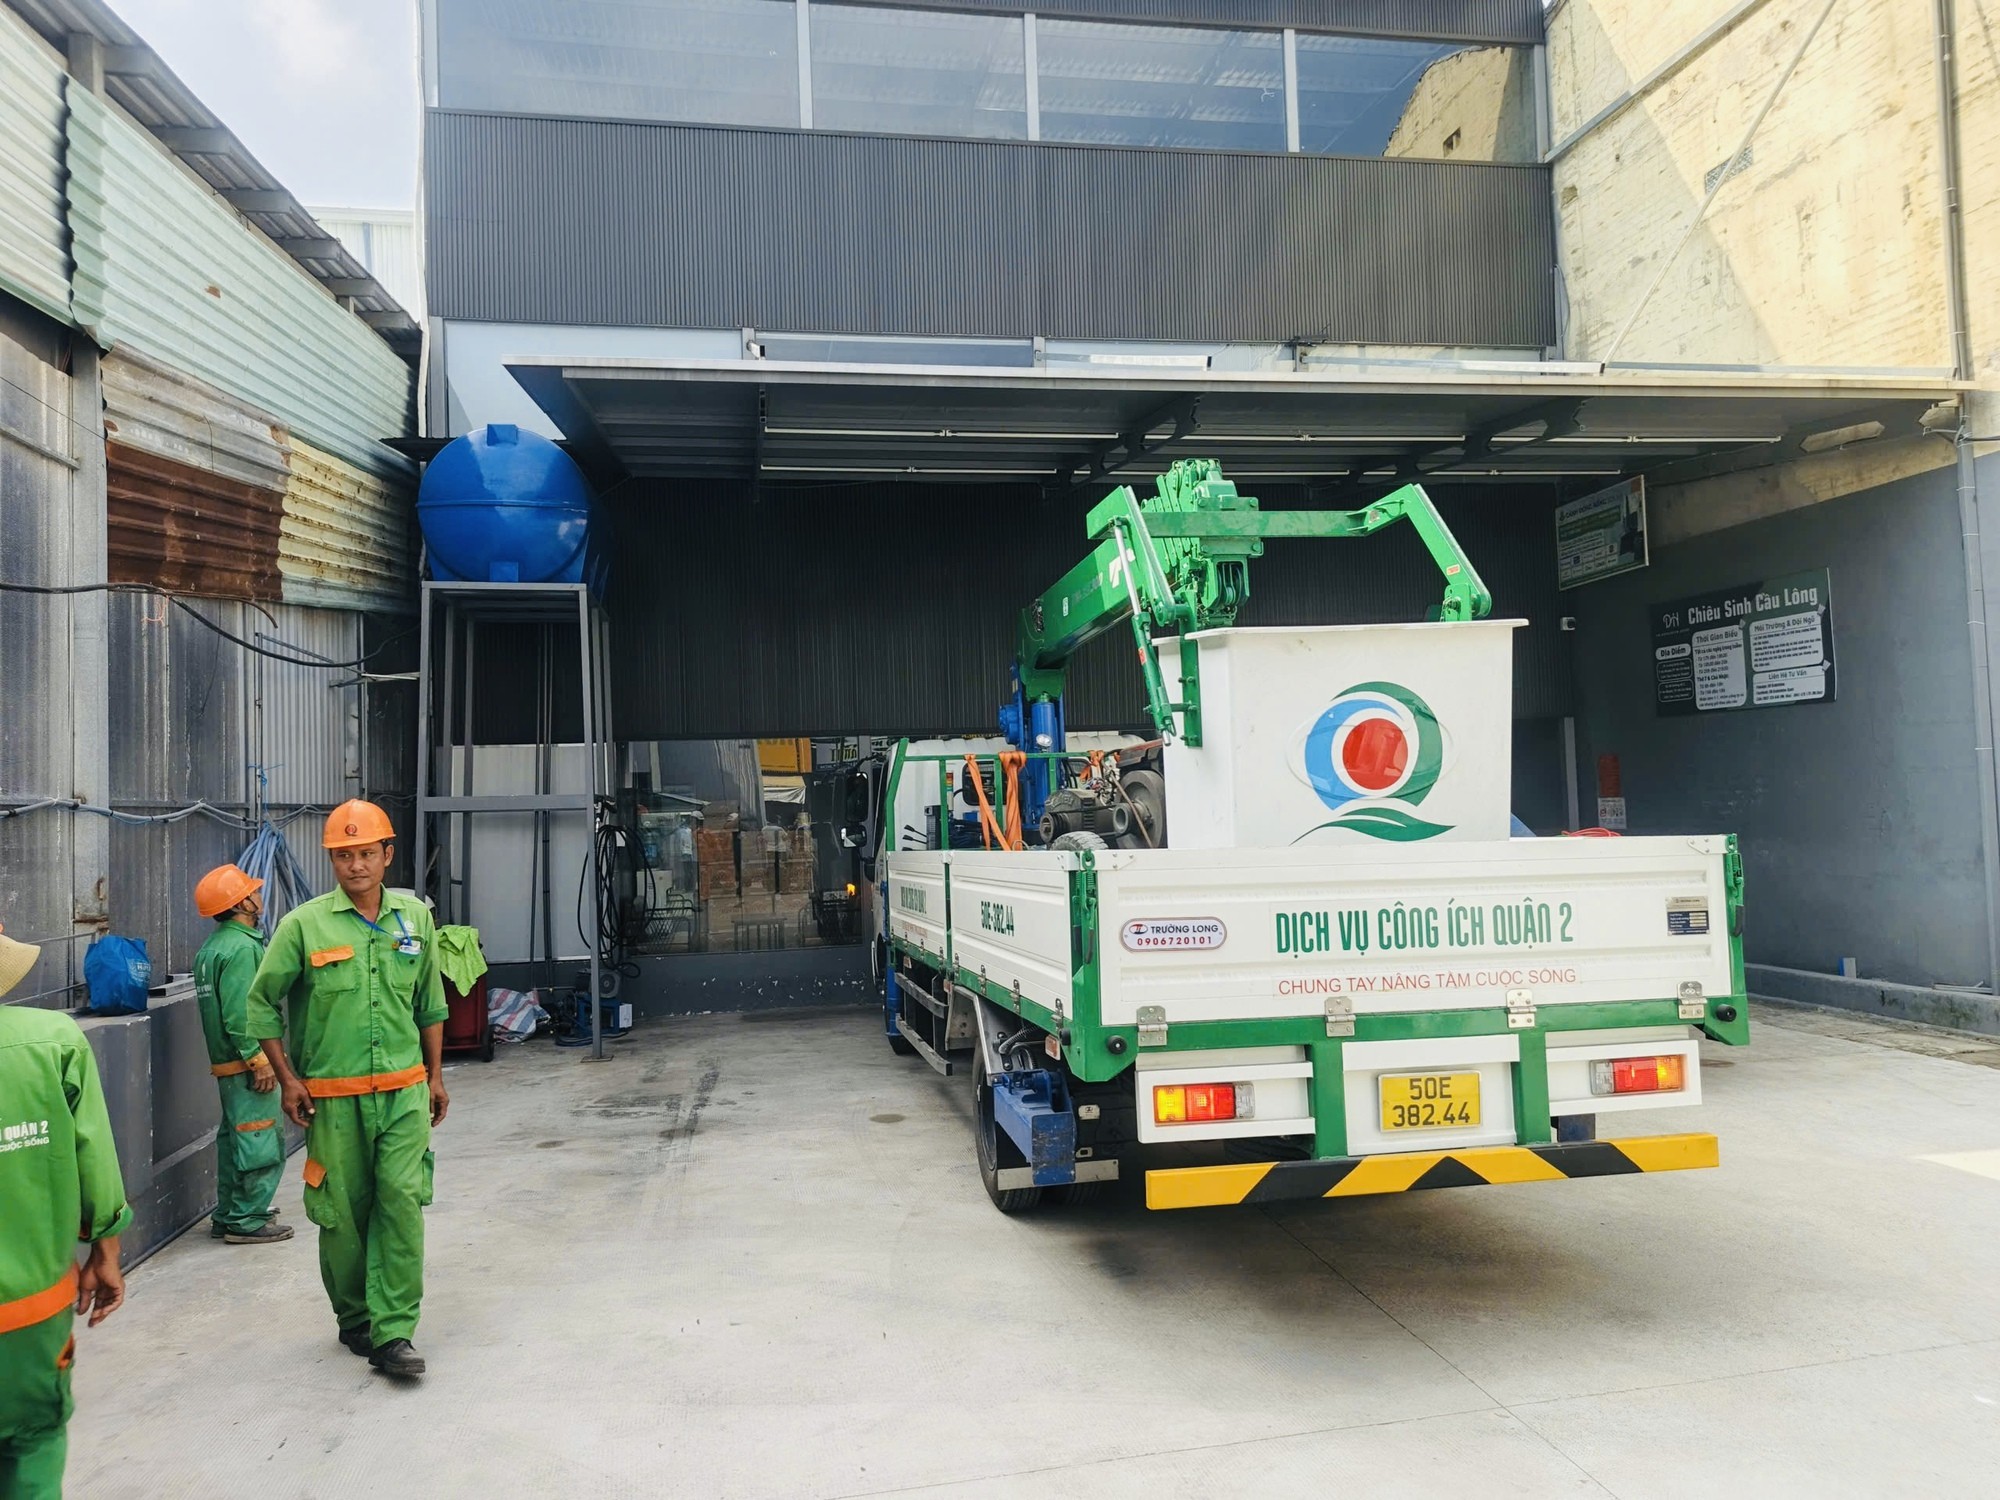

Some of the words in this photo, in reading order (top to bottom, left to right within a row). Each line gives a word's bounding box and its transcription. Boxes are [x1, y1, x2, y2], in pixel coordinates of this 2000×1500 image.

[1688, 606, 1721, 625] Chiêu
[1724, 597, 1752, 618] Sinh
[1755, 592, 1780, 612] Cầu
[1784, 587, 1818, 606] Lông
[1151, 924, 1190, 934] TRƯỜNG
[1192, 924, 1219, 933] LONG
[1276, 911, 1330, 959] DỊCH
[1338, 910, 1369, 956] VỤ
[1378, 901, 1439, 950] CÔNG
[1447, 898, 1484, 947] ÍCH
[1492, 896, 1552, 949] QUẬN
[1559, 902, 1574, 942] 2
[1137, 936, 1212, 946] 0906720101
[1278, 978, 1342, 995] CHUNG
[1346, 976, 1377, 992] TAY
[1382, 972, 1431, 991] NÂNG
[1409, 1076, 1452, 1100] 50E
[1392, 1101, 1470, 1127] 382.44
[4, 1121, 38, 1141] QUẬN
[40, 1120, 49, 1134] 2
